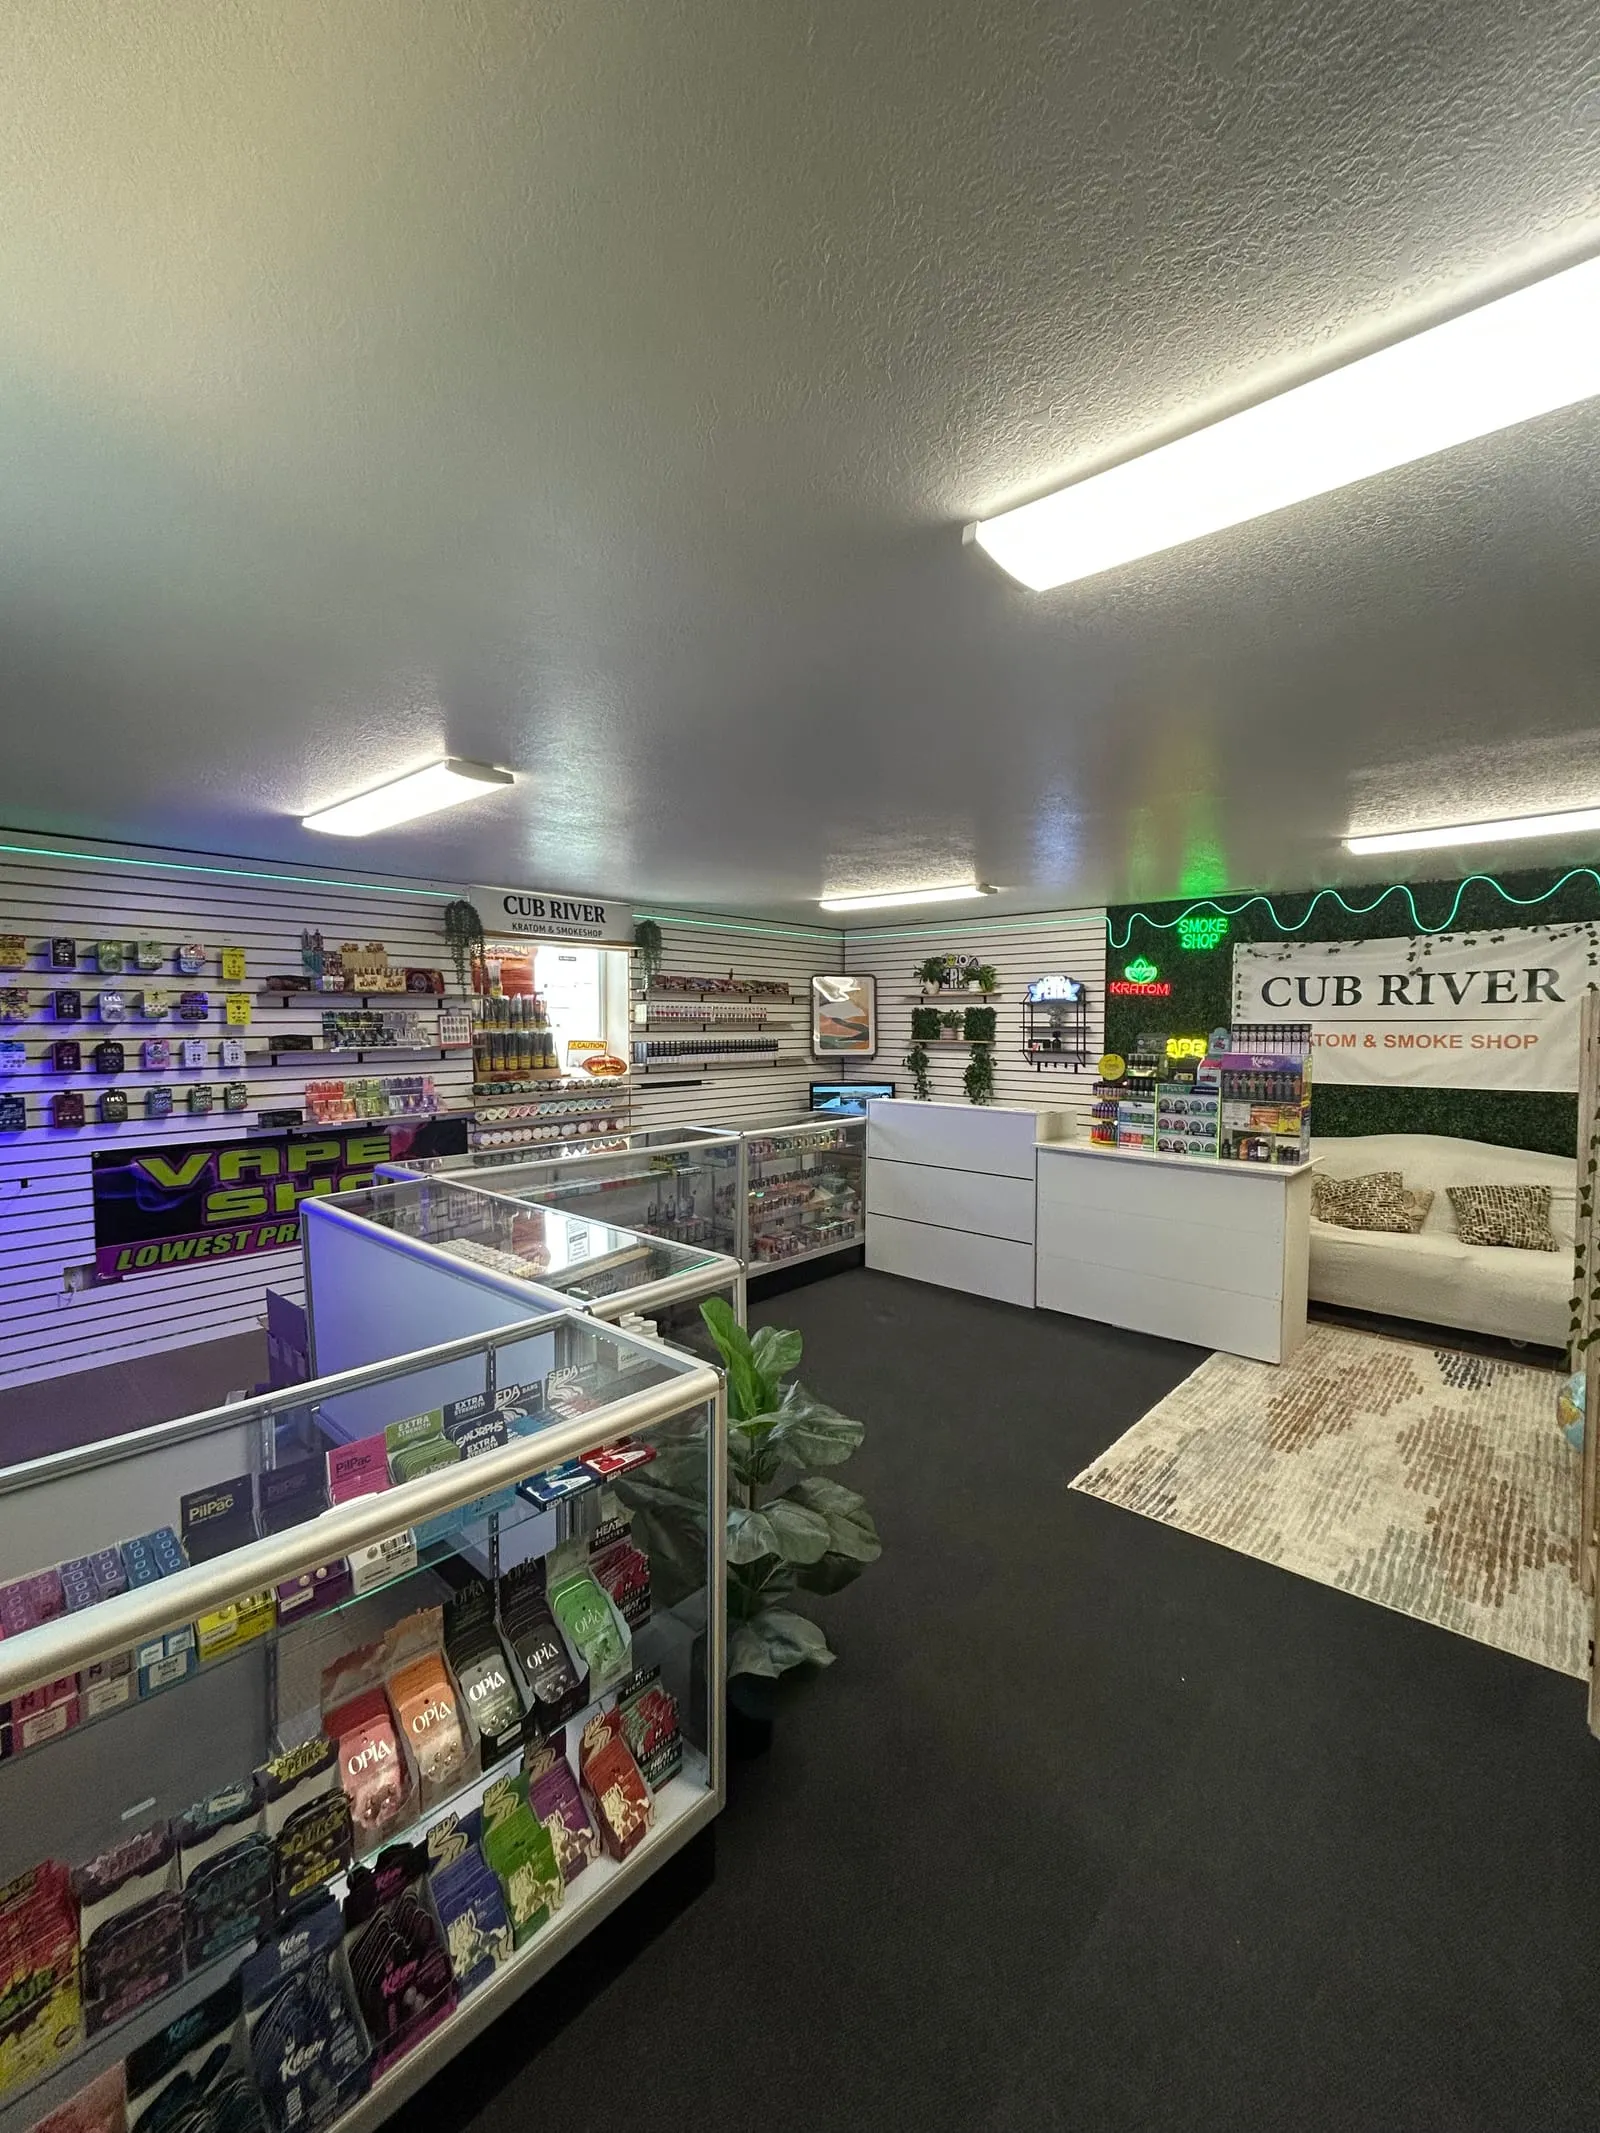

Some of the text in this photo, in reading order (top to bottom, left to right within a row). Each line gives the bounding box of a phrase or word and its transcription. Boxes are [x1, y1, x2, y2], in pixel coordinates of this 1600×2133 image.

[503, 895, 606, 924] CUB RIVER
[512, 922, 602, 938] KRATOM & SMOKESHOP
[1177, 918, 1229, 934] SMOKE
[1181, 933, 1219, 950] SHOP
[1109, 981, 1172, 996] KRATOM
[1261, 968, 1566, 1008] CUB RIVER
[577, 1042, 605, 1050] CAUTION
[1309, 1033, 1540, 1050] TOM & SMOKE SHOP
[136, 1135, 392, 1189] VAPE
[115, 1230, 253, 1272] LOWEST
[548, 1365, 578, 1383] SEDA
[454, 1394, 486, 1410] EXTRA
[495, 1385, 521, 1402] EDA
[454, 1401, 486, 1416] STRENGTH
[397, 1421, 432, 1438] STRENGTH
[398, 1415, 430, 1432] EXTRA
[467, 1435, 499, 1453] EXTRA
[336, 1454, 372, 1474] PilPac
[189, 1495, 234, 1522] PilPac
[596, 1519, 623, 1539] HEAT
